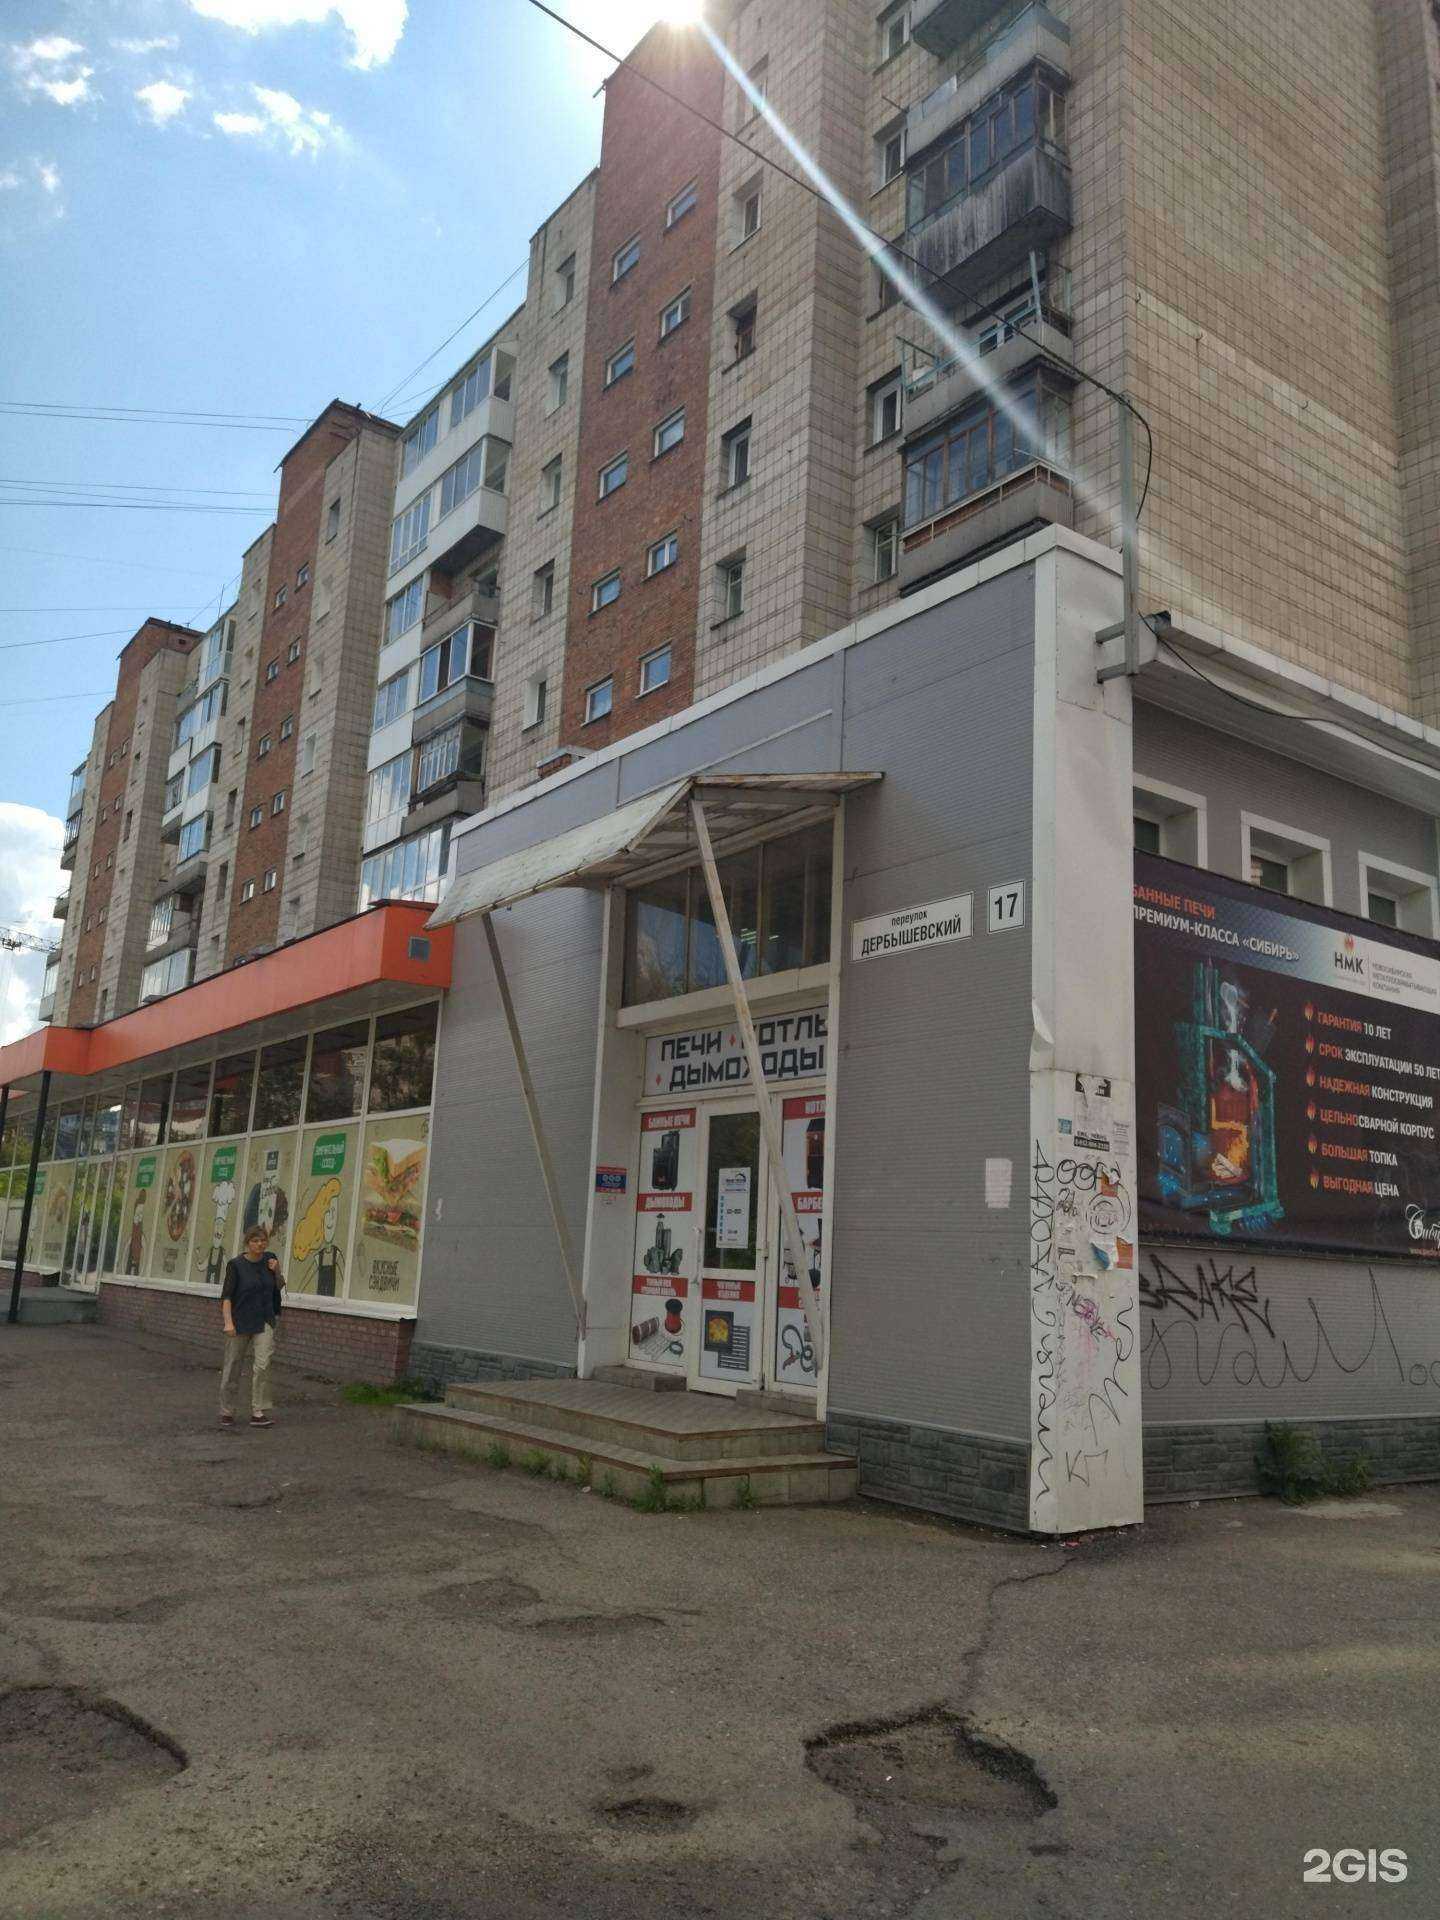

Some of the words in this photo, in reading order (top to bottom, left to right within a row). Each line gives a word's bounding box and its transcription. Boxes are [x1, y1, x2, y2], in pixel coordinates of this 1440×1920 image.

[891, 909, 928, 927] переулок
[994, 892, 1019, 920] 17
[1183, 899, 1216, 921] ПЕЧИ
[861, 914, 962, 957] ДЕРБЫШЕВСКИЙ
[1133, 903, 1240, 947] ПРЕМИУМ-КЛАССА
[1242, 936, 1300, 962] «СИБИРЬ»
[1334, 951, 1364, 975] НМК
[1318, 1011, 1362, 1033] ГАРАНТИЯ
[1363, 1022, 1374, 1036] 10
[1375, 1025, 1392, 1040] ЛЕТ
[661, 1031, 722, 1061] ПЕЧИ
[1319, 1043, 1343, 1059] СРОК
[1345, 1048, 1413, 1074] ЭКСПЛУАТАЦИИ
[1413, 1063, 1425, 1077] 50
[1425, 1066, 1440, 1079] ЛЕТ
[1320, 1076, 1370, 1097] НАДЕЖНАЯ
[1371, 1085, 1433, 1109] КОНСТРУКЦИЯ
[1320, 1108, 1399, 1133] ЦЕЛЬНОСВАРНОЙ
[1400, 1122, 1435, 1140] КОРПУС
[1321, 1143, 1368, 1162] БОЛЬШАЯ
[1369, 1150, 1398, 1167] ТОПКА
[1323, 1175, 1373, 1195] ВЫГОДНАЯ
[1374, 1182, 1400, 1198] ЦЕНА
